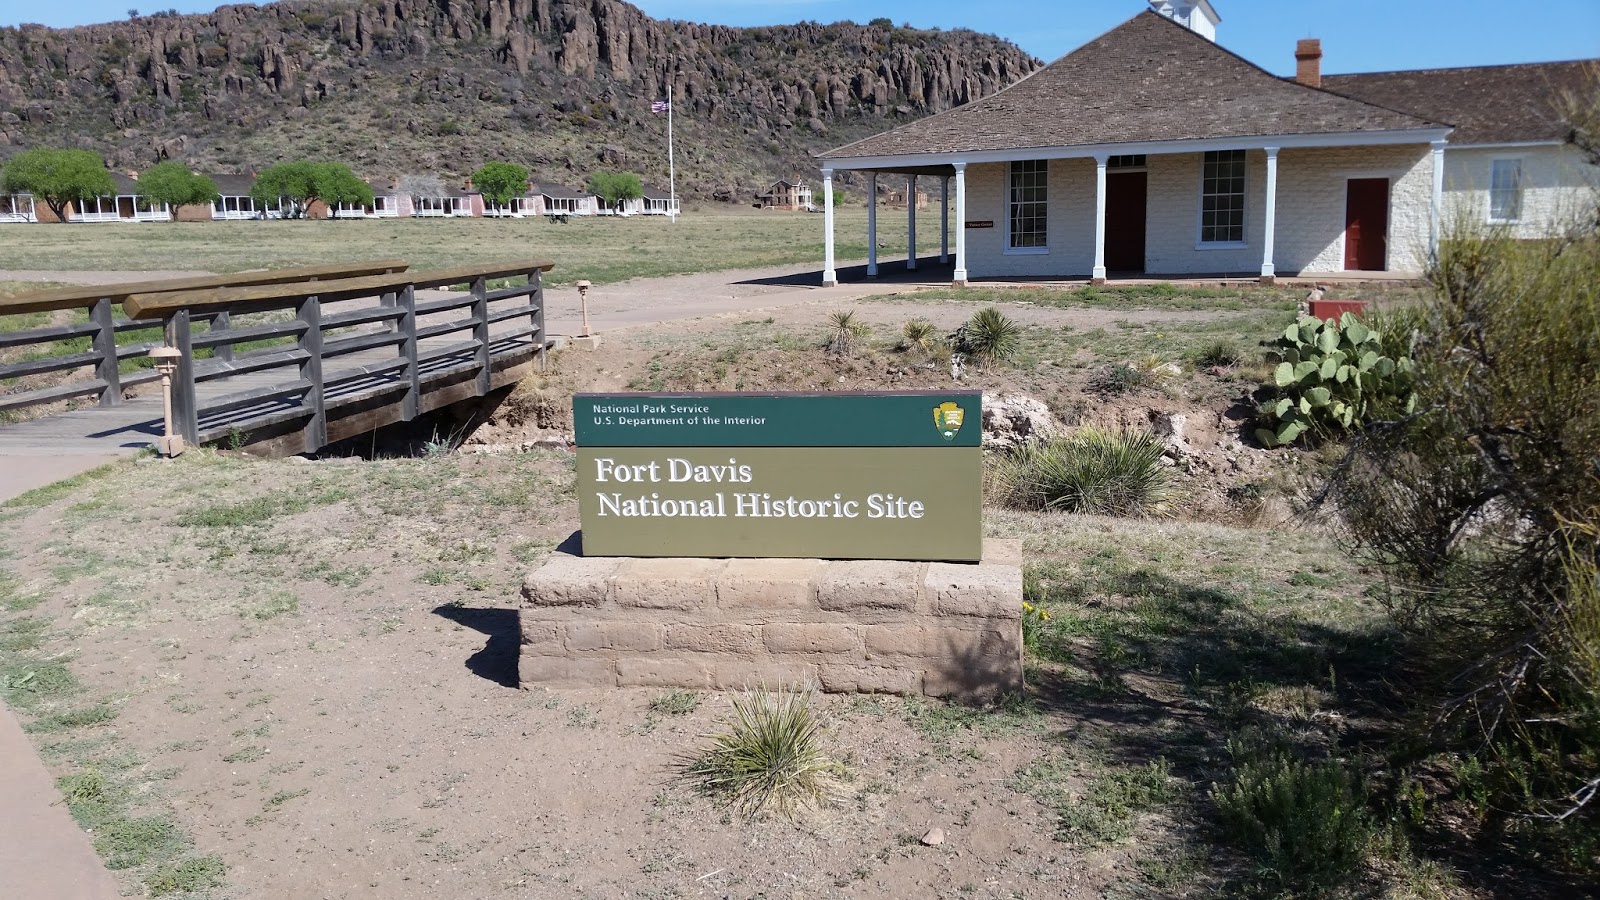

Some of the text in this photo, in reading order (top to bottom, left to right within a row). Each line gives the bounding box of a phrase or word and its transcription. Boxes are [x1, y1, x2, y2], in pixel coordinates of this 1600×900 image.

[593, 404, 709, 413] National Park Service
[594, 416, 766, 428] U.S. Department of the Interior
[595, 458, 752, 482] Fort Davis
[597, 493, 925, 518] National Historic Site
